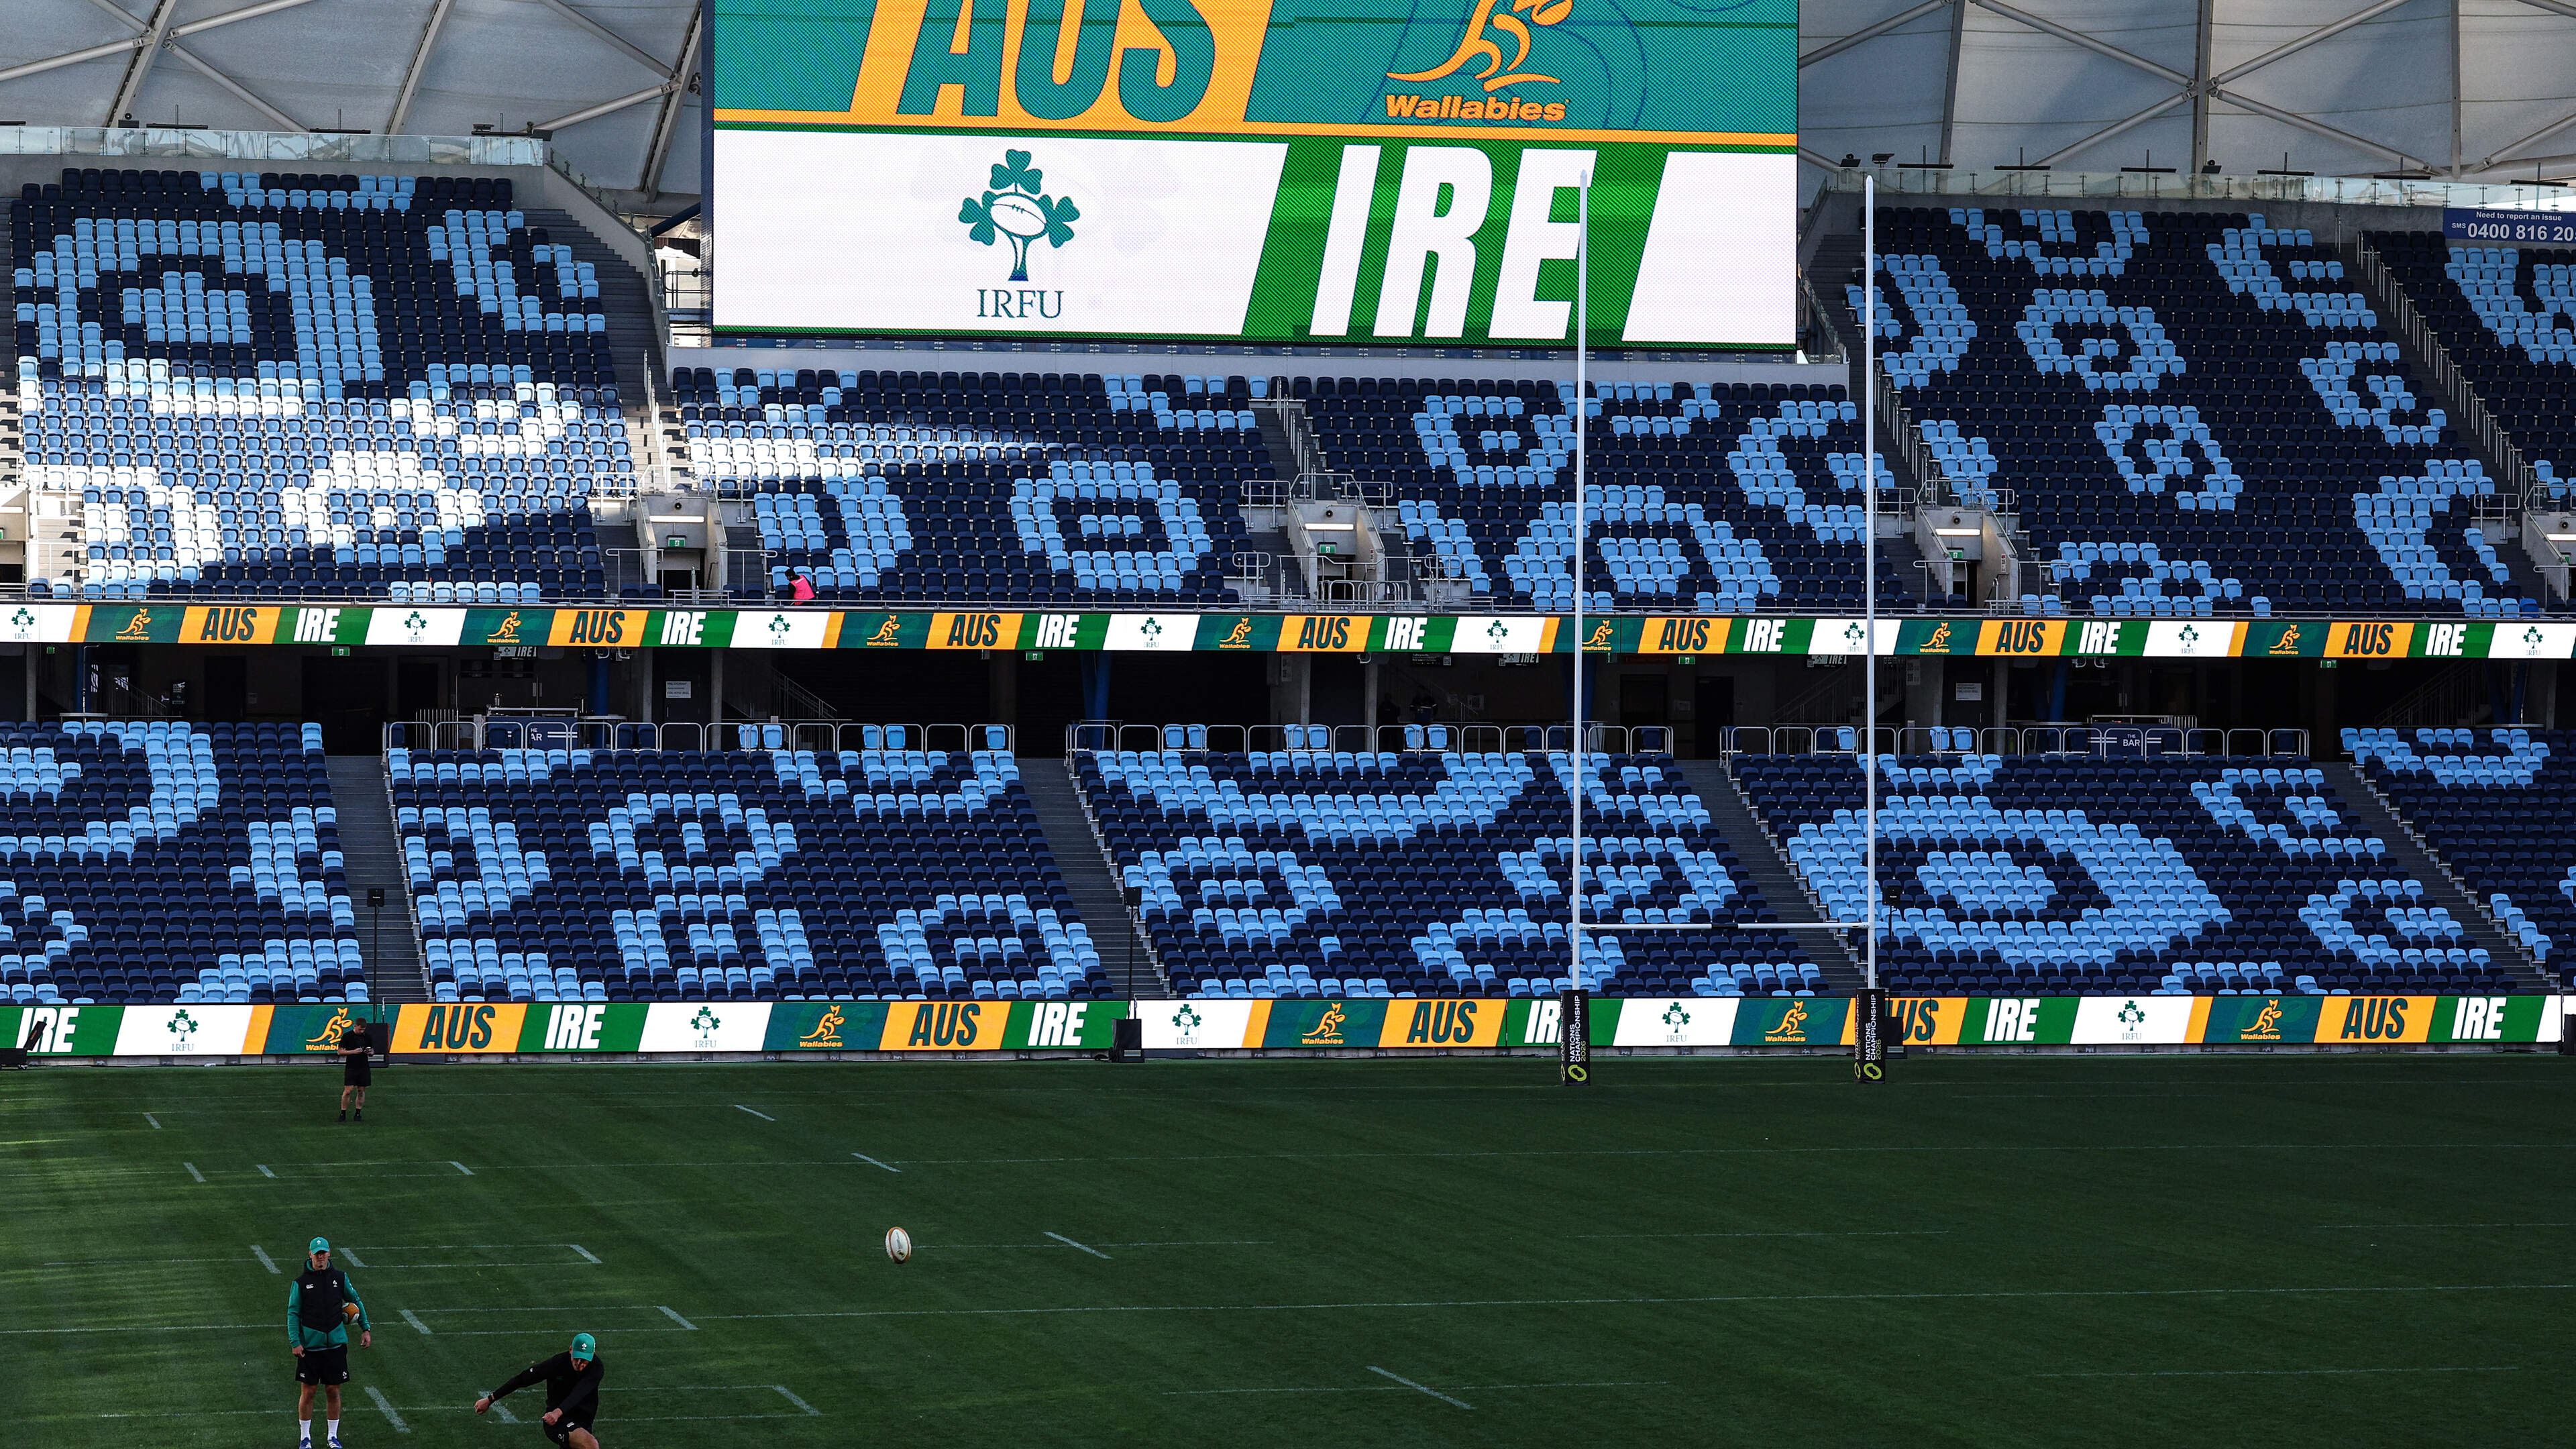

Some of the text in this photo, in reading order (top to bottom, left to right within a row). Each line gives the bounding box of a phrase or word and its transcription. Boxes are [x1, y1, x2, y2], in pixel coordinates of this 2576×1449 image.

[896, 0, 1216, 123] AUS
[1386, 94, 1566, 122] Wallabies
[1308, 144, 1598, 339] IRE
[2467, 223, 2510, 239] 0400
[2516, 225, 2547, 239] 816
[2553, 226, 2576, 241] 20
[977, 288, 1064, 319] IRFU
[201, 608, 256, 641] AUS
[294, 608, 341, 642] IRE
[569, 611, 625, 643] AUS
[660, 612, 707, 645] IRE
[947, 615, 1000, 646] AUS
[1035, 615, 1080, 647] IRE
[1297, 617, 1350, 649] AUS
[1384, 618, 1428, 650] IRE
[1659, 620, 1710, 651] AUS
[1743, 620, 1786, 651] IRE
[1995, 622, 2045, 653] AUS
[2078, 622, 2121, 654] IRE
[2344, 624, 2393, 655] AUS
[2425, 624, 2467, 655] IRE
[15, 1007, 79, 1053] IRE
[419, 1006, 496, 1049] AUS
[543, 1005, 606, 1049] IRE
[908, 1004, 981, 1047] AUS
[1028, 1002, 1088, 1046] IRE
[1407, 1001, 1478, 1044] AUS
[1524, 1000, 1561, 1044] IR
[1884, 999, 1939, 1041] US
[1983, 998, 2041, 1041] IRE
[2341, 998, 2408, 1039] AUS
[2451, 997, 2507, 1040] IRE
